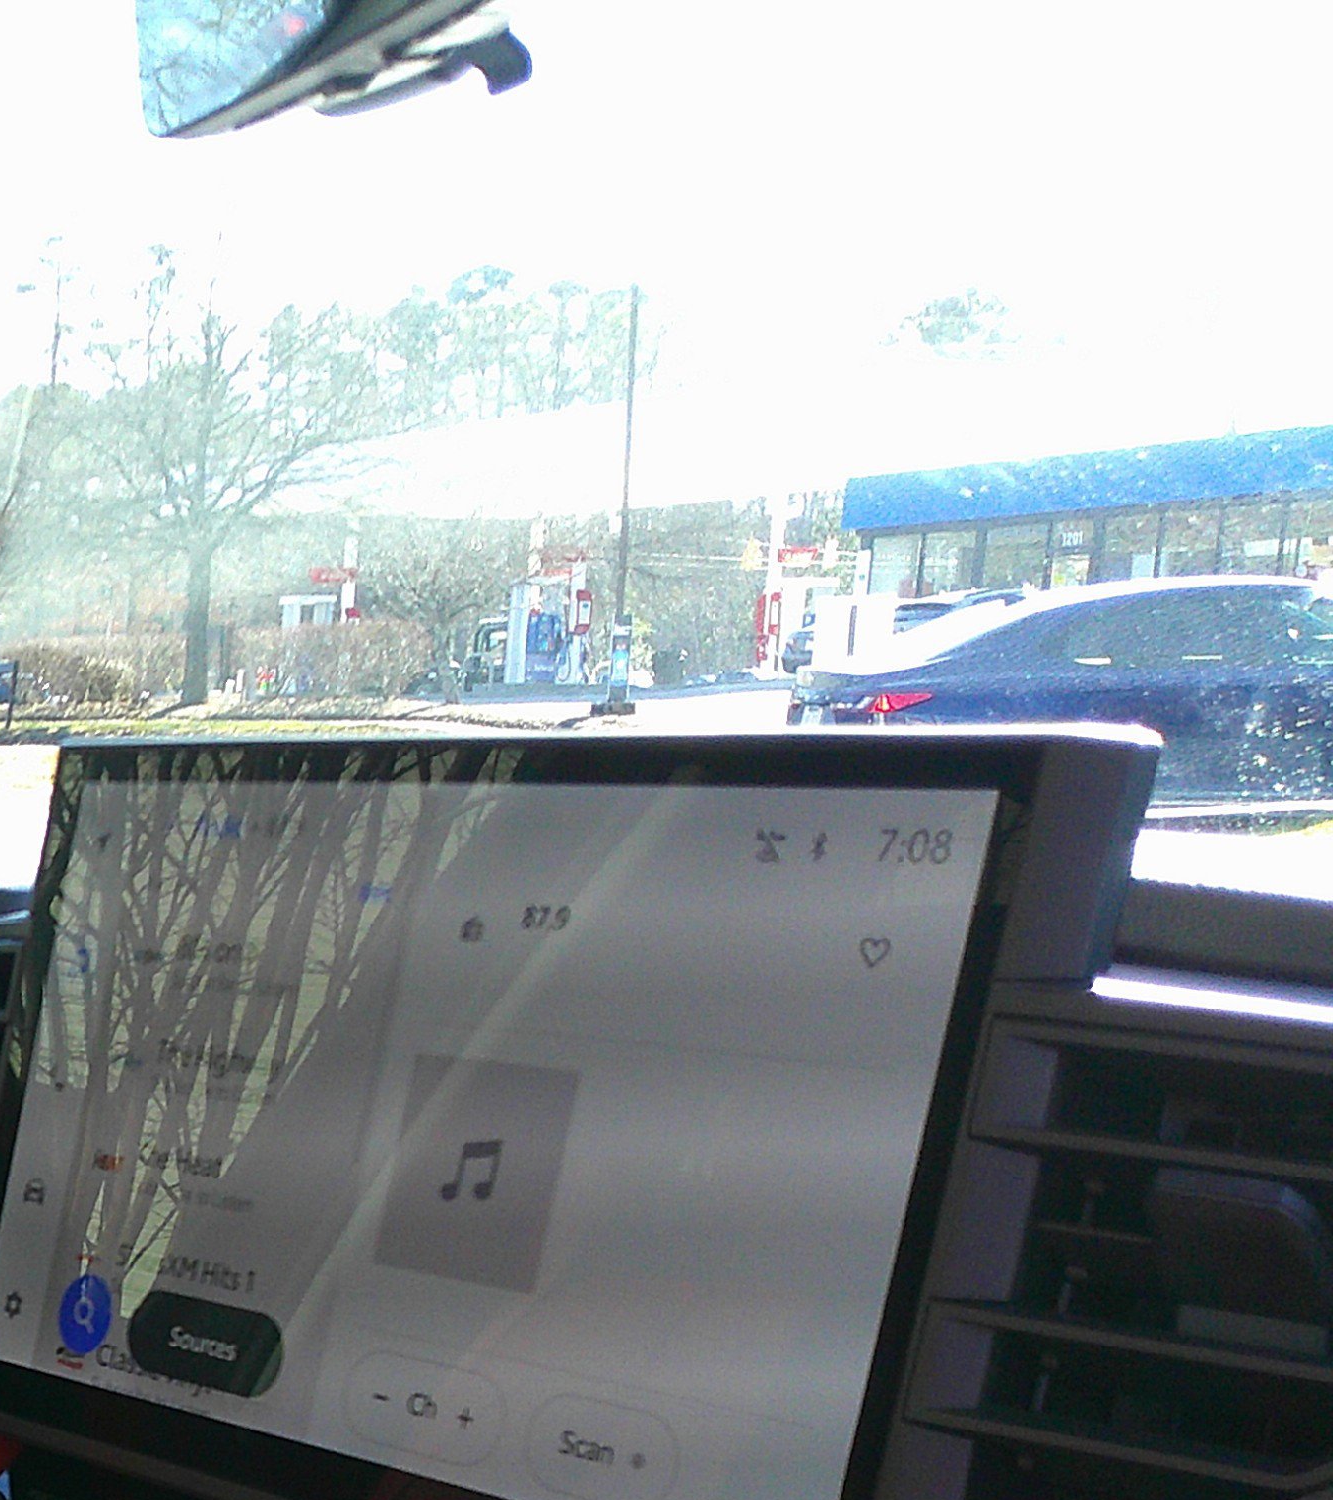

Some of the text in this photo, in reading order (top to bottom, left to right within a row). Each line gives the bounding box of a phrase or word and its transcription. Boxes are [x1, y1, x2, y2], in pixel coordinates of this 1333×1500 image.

[1062, 531, 1084, 547] 1201
[878, 828, 954, 865] 7:08
[168, 1325, 238, 1362] Sources
[558, 1430, 615, 1465] Scan
